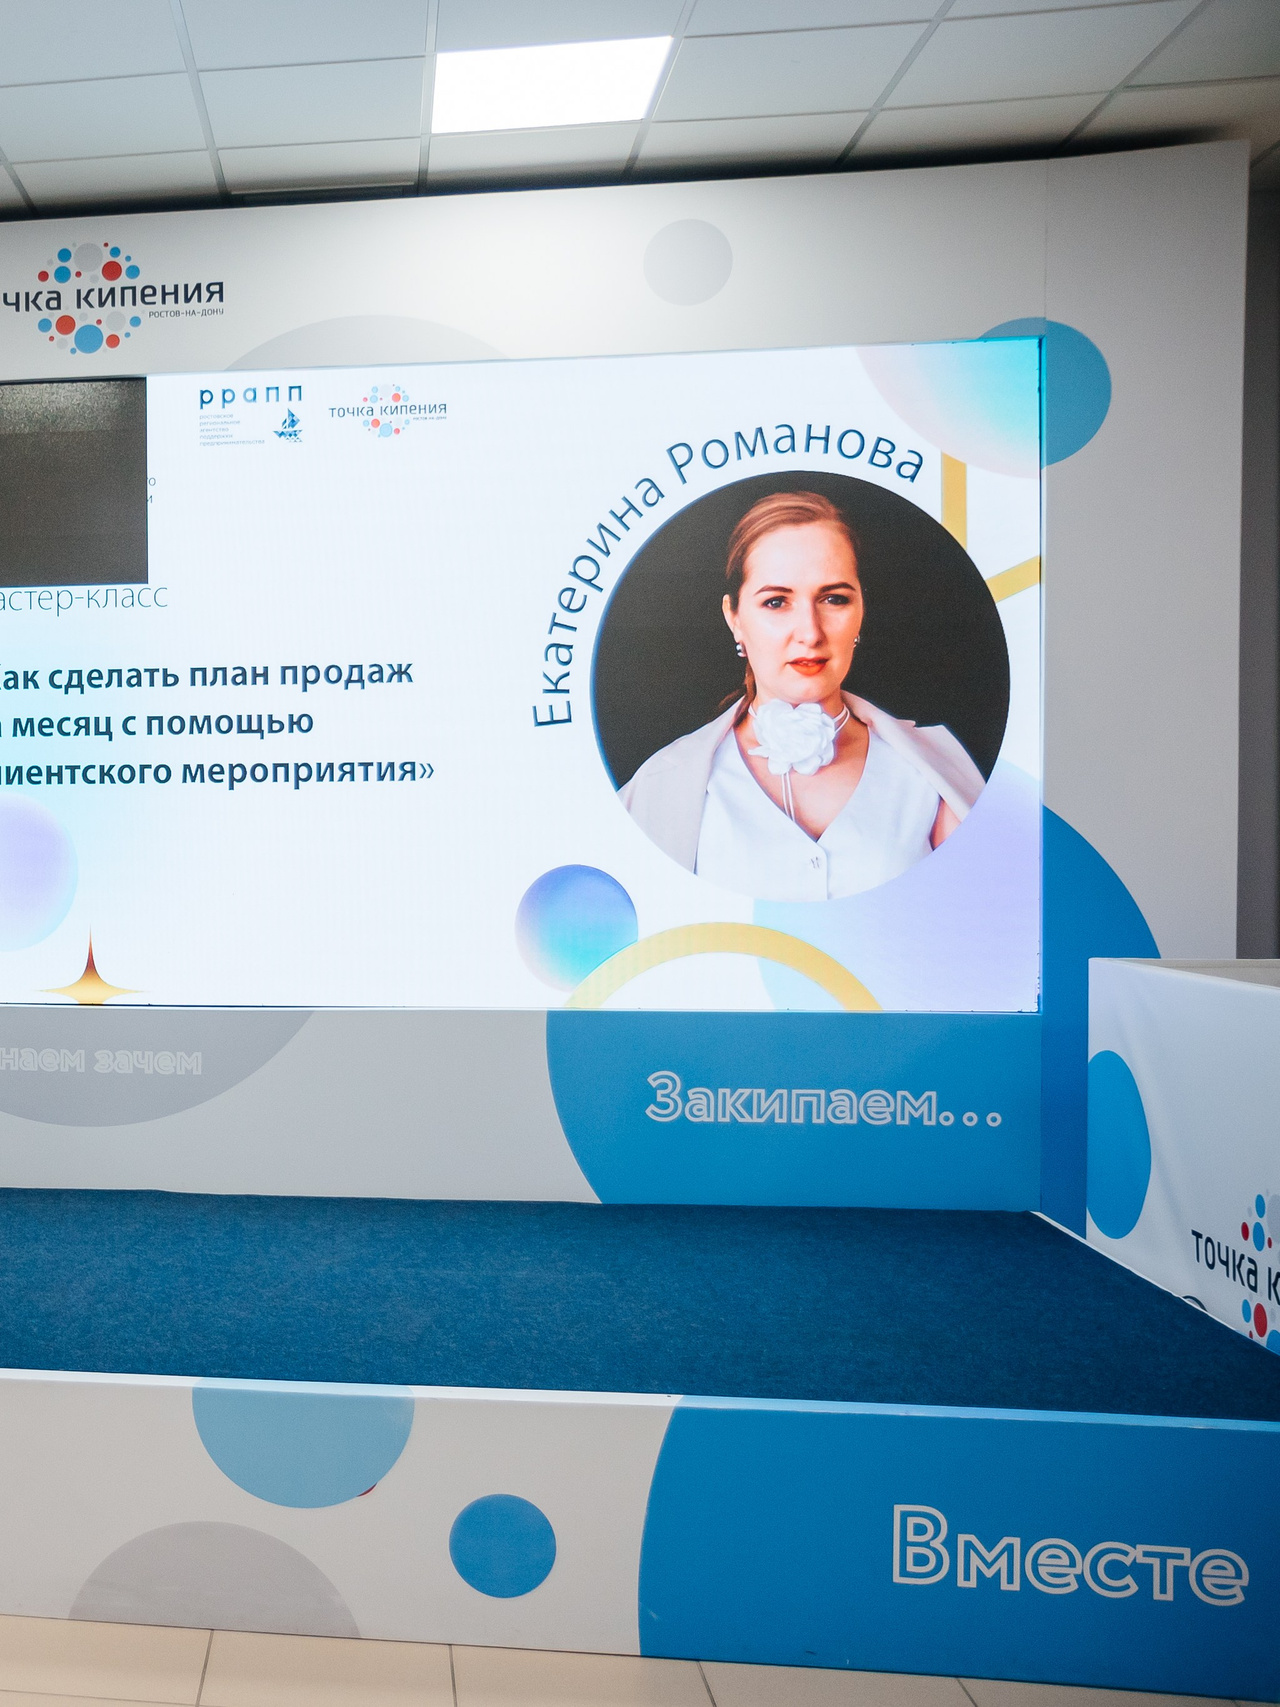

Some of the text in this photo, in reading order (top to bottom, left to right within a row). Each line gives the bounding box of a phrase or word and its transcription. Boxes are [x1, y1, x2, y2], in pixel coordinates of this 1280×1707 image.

[76, 281, 224, 309] кипения
[148, 308, 224, 318] РОСТОВ-НА-ДОНУ
[329, 403, 447, 418] точка кипения
[532, 423, 924, 727] Екатерина Романова
[48, 668, 179, 695] сделать
[189, 665, 269, 687] план
[280, 663, 414, 693] продаж
[12, 715, 113, 742] месяц
[121, 715, 137, 736] с
[146, 713, 314, 740] помощью
[181, 761, 435, 791] мероприятия»
[93, 1049, 203, 1075] зачем
[645, 1070, 1002, 1127] Закипаем...
[1191, 1229, 1258, 1293] точка
[892, 1504, 1250, 1606] Вместе
